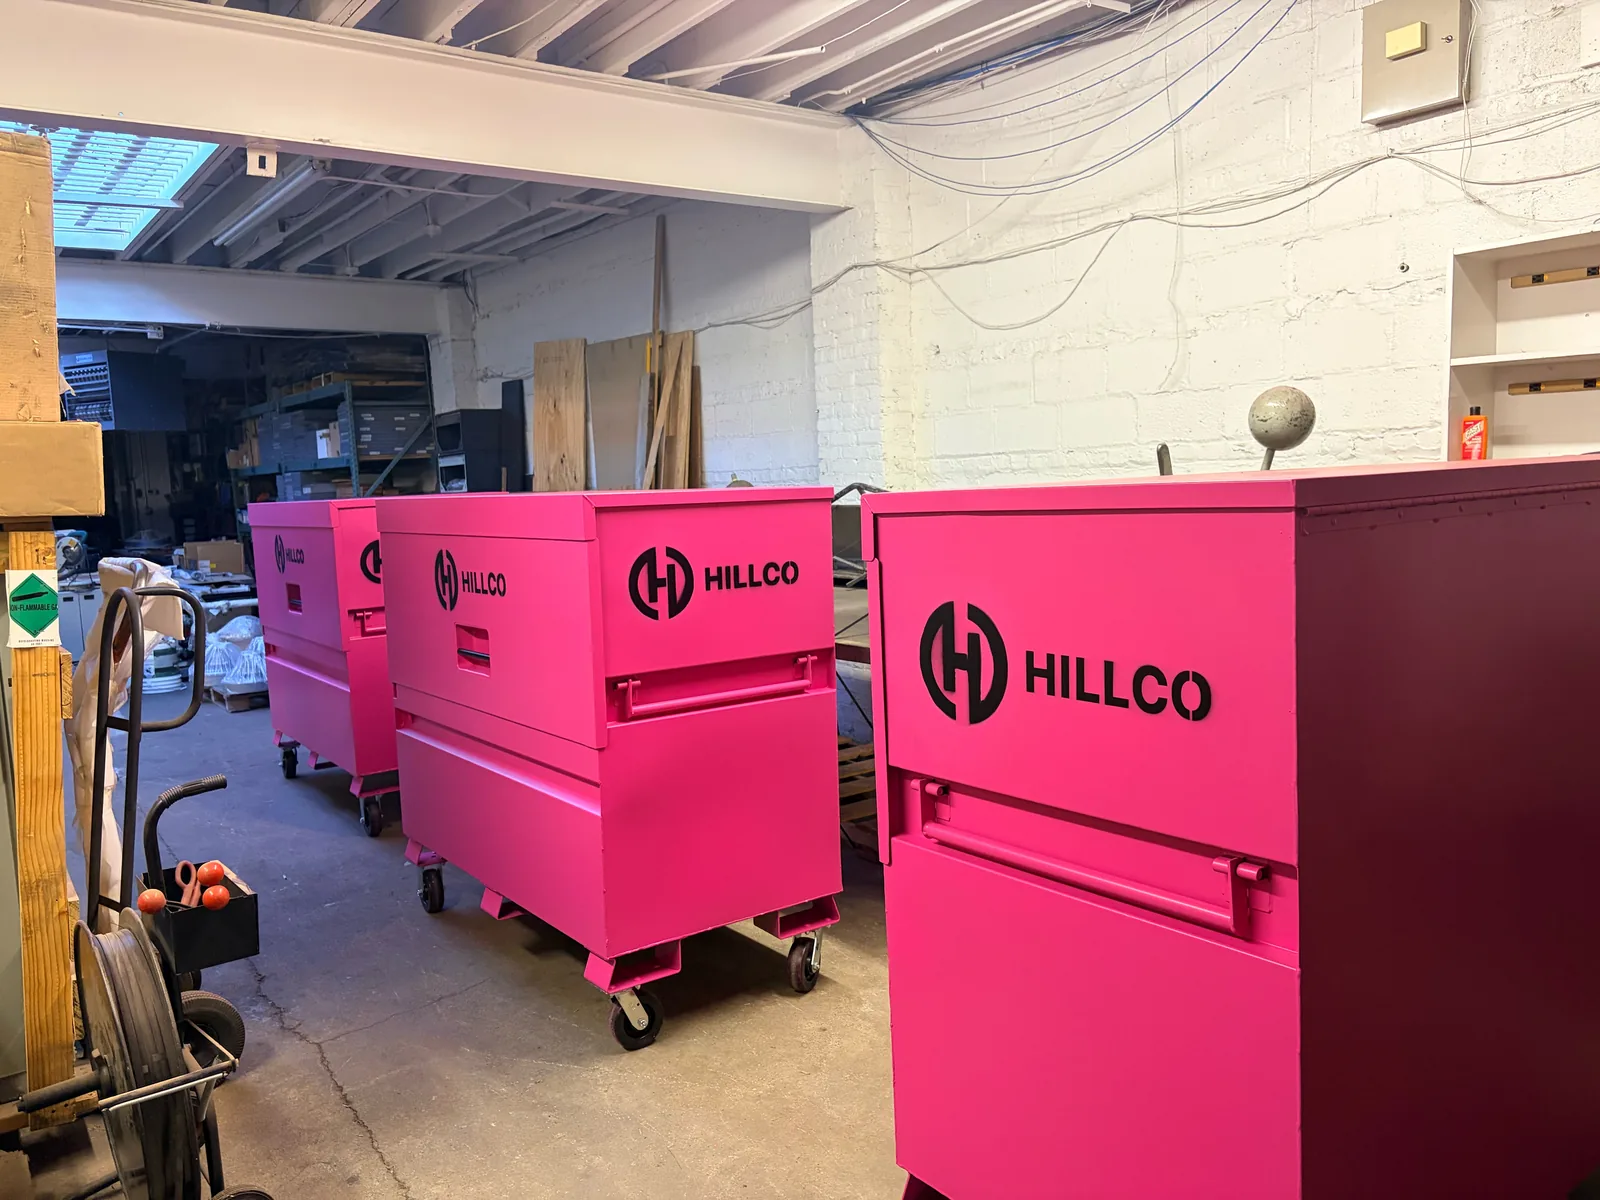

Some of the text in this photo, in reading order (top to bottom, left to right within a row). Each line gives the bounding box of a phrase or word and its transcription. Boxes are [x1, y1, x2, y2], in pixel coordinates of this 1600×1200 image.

[286, 549, 304, 565] HILLCO
[462, 571, 506, 596] HILLCO
[705, 561, 799, 592] HILLCO
[1026, 651, 1212, 721] HILLCO
